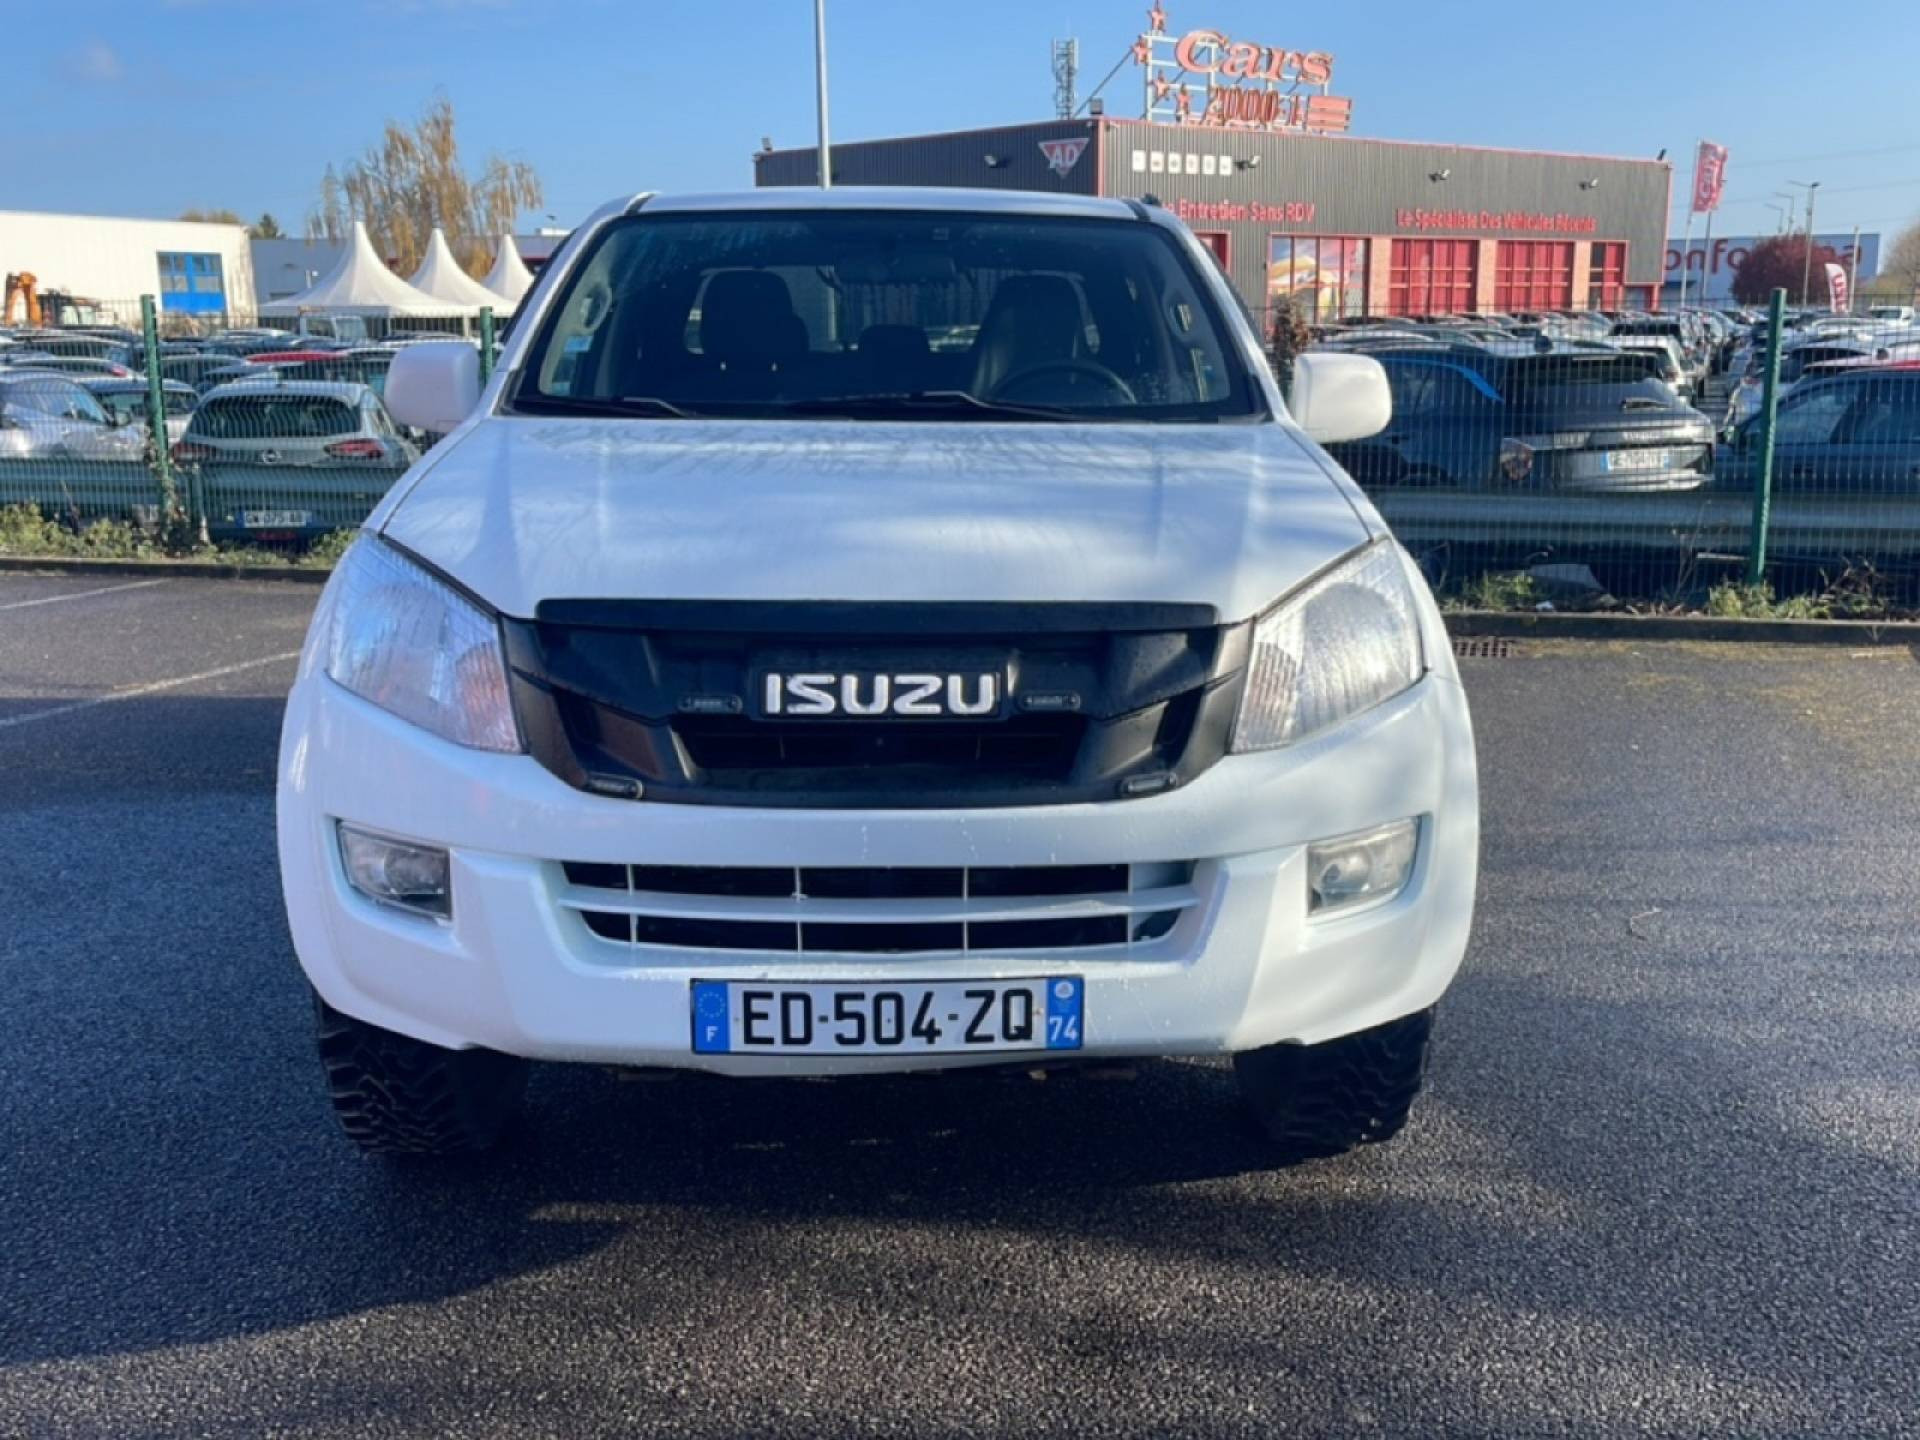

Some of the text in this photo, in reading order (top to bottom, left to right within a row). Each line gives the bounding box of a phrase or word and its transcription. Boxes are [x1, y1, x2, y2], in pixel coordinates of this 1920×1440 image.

[1175, 30, 1333, 85] Cars
[1049, 143, 1080, 169] AD
[1178, 197, 1246, 220] Entretien
[1251, 201, 1284, 222] Sans
[1286, 202, 1316, 223] RDV
[766, 673, 997, 715] ISUZU
[706, 988, 1078, 1046] F ED-504-ZQ 74
